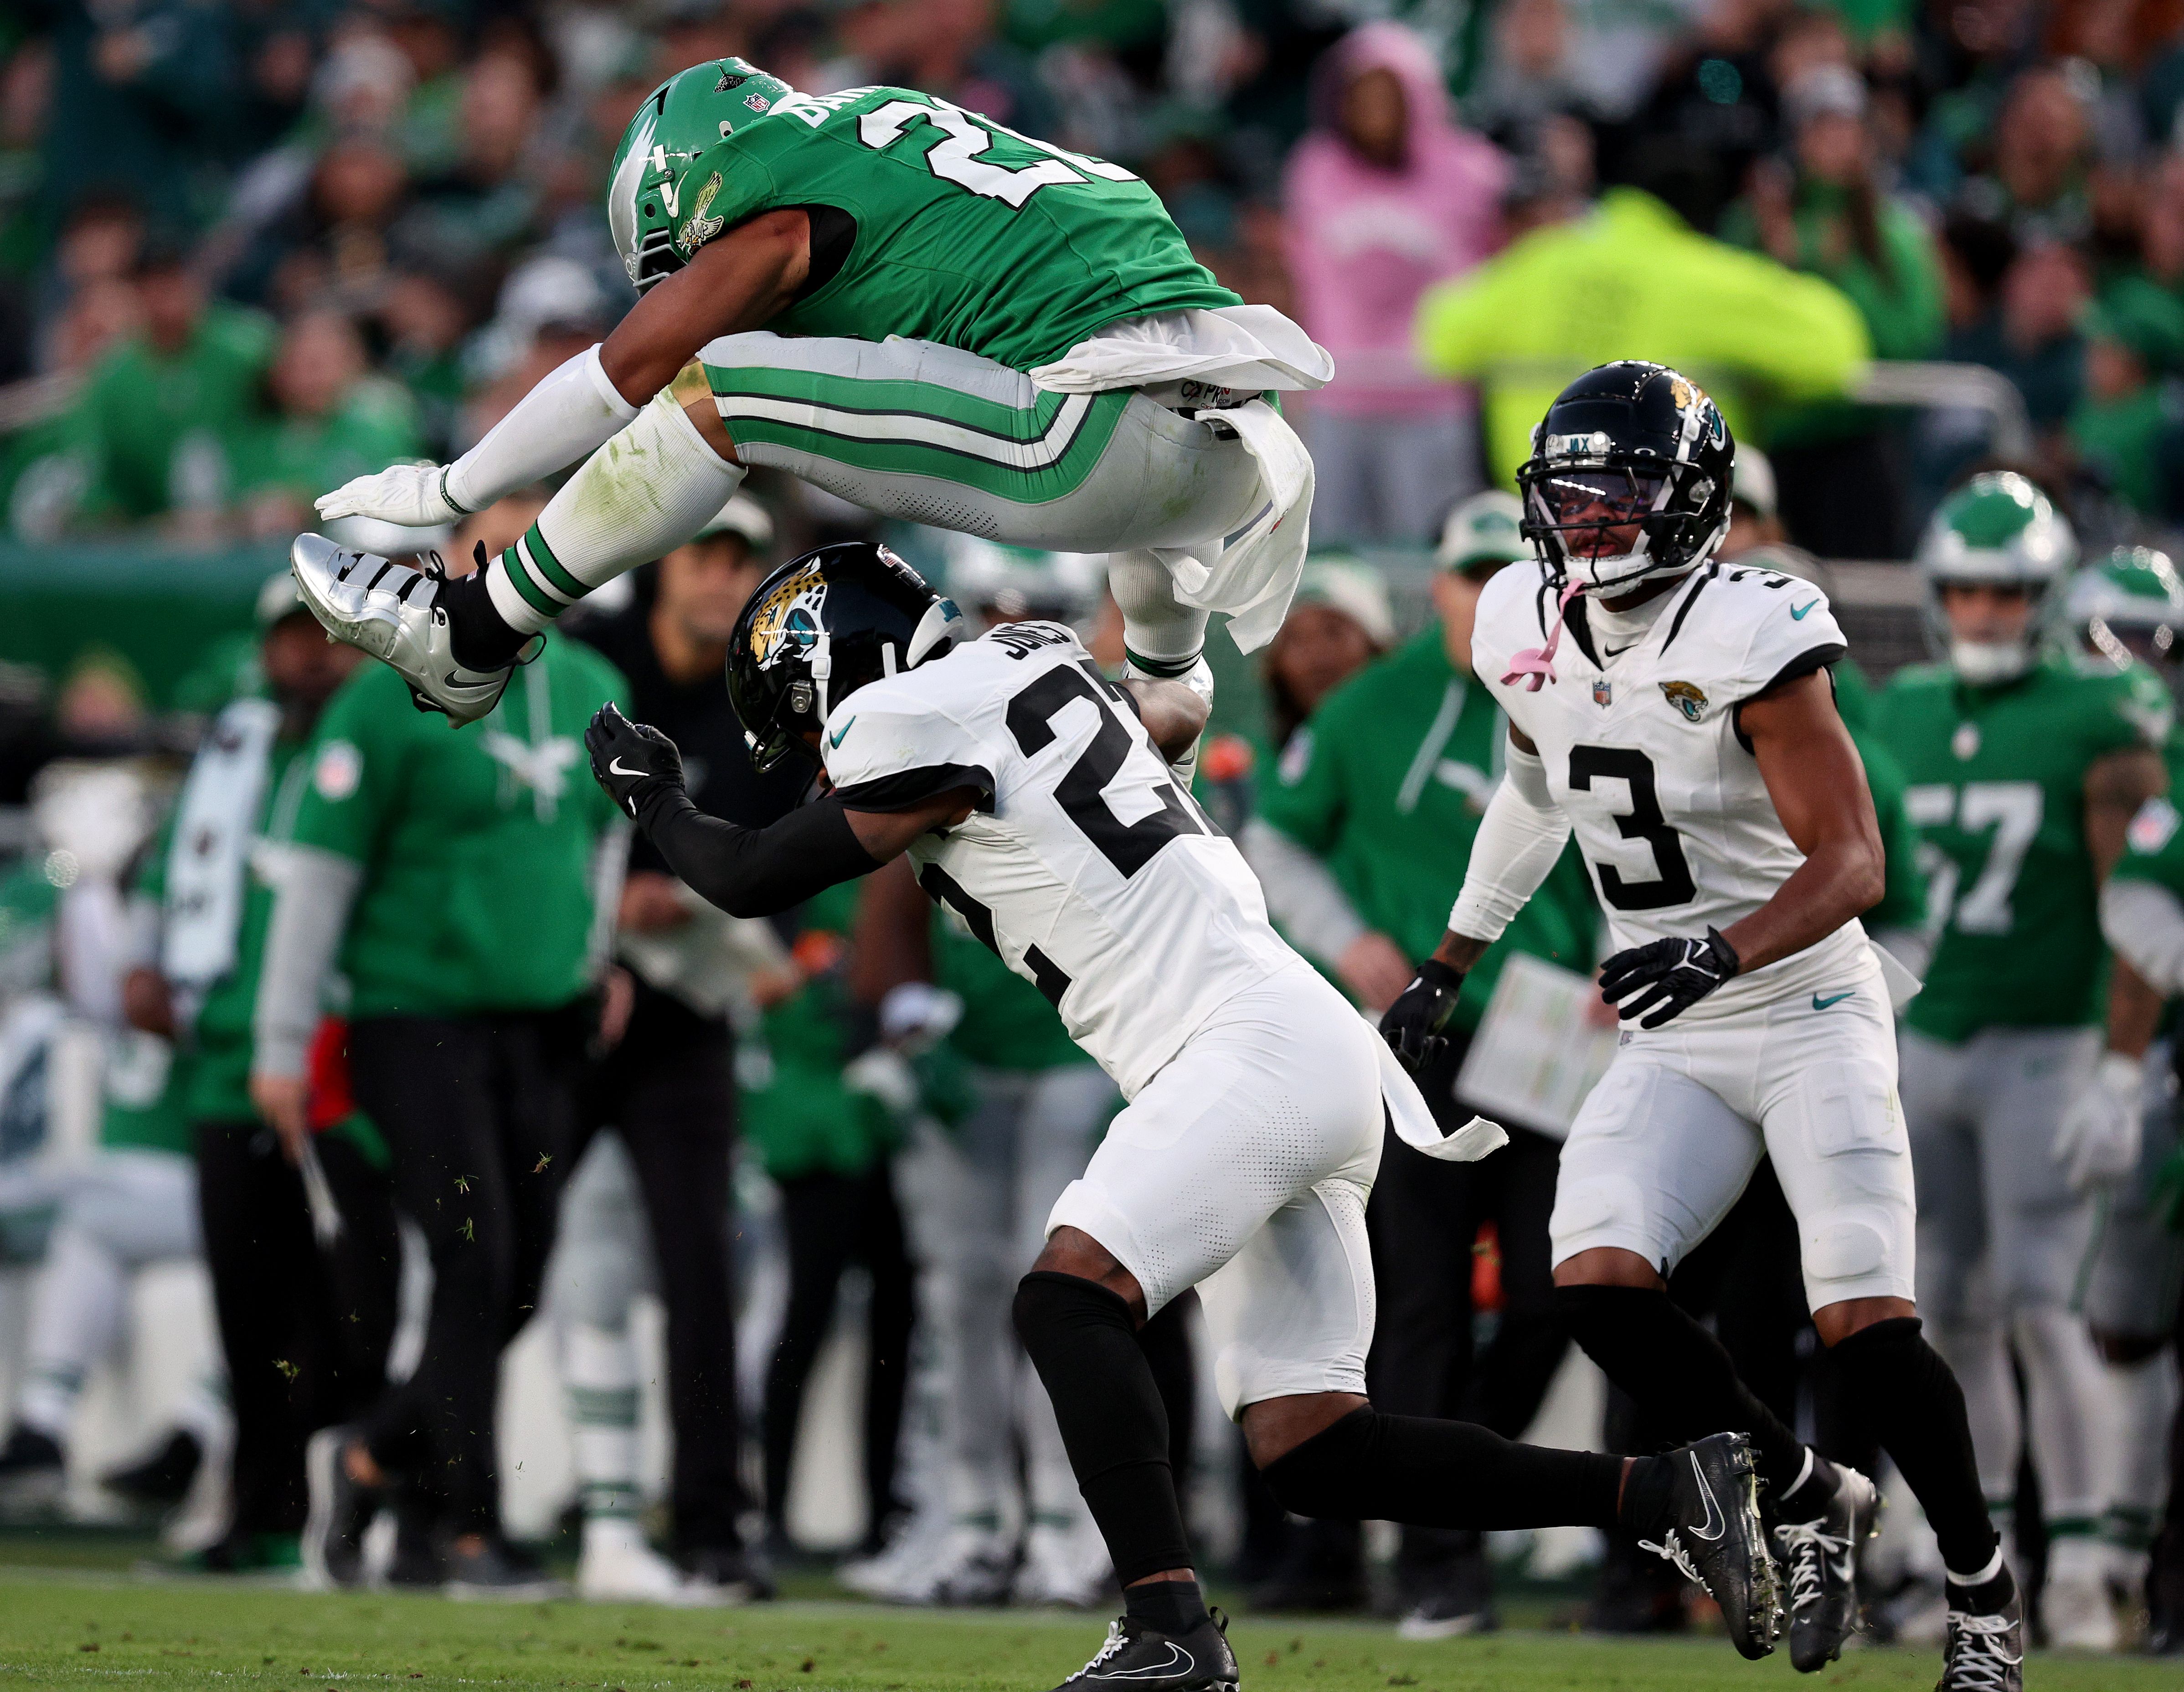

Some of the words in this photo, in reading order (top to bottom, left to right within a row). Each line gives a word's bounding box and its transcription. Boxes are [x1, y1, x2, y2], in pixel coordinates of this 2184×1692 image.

[752, 100, 767, 109] NFL
[1566, 438, 1589, 453] JAX
[1569, 744, 1697, 910] 3
